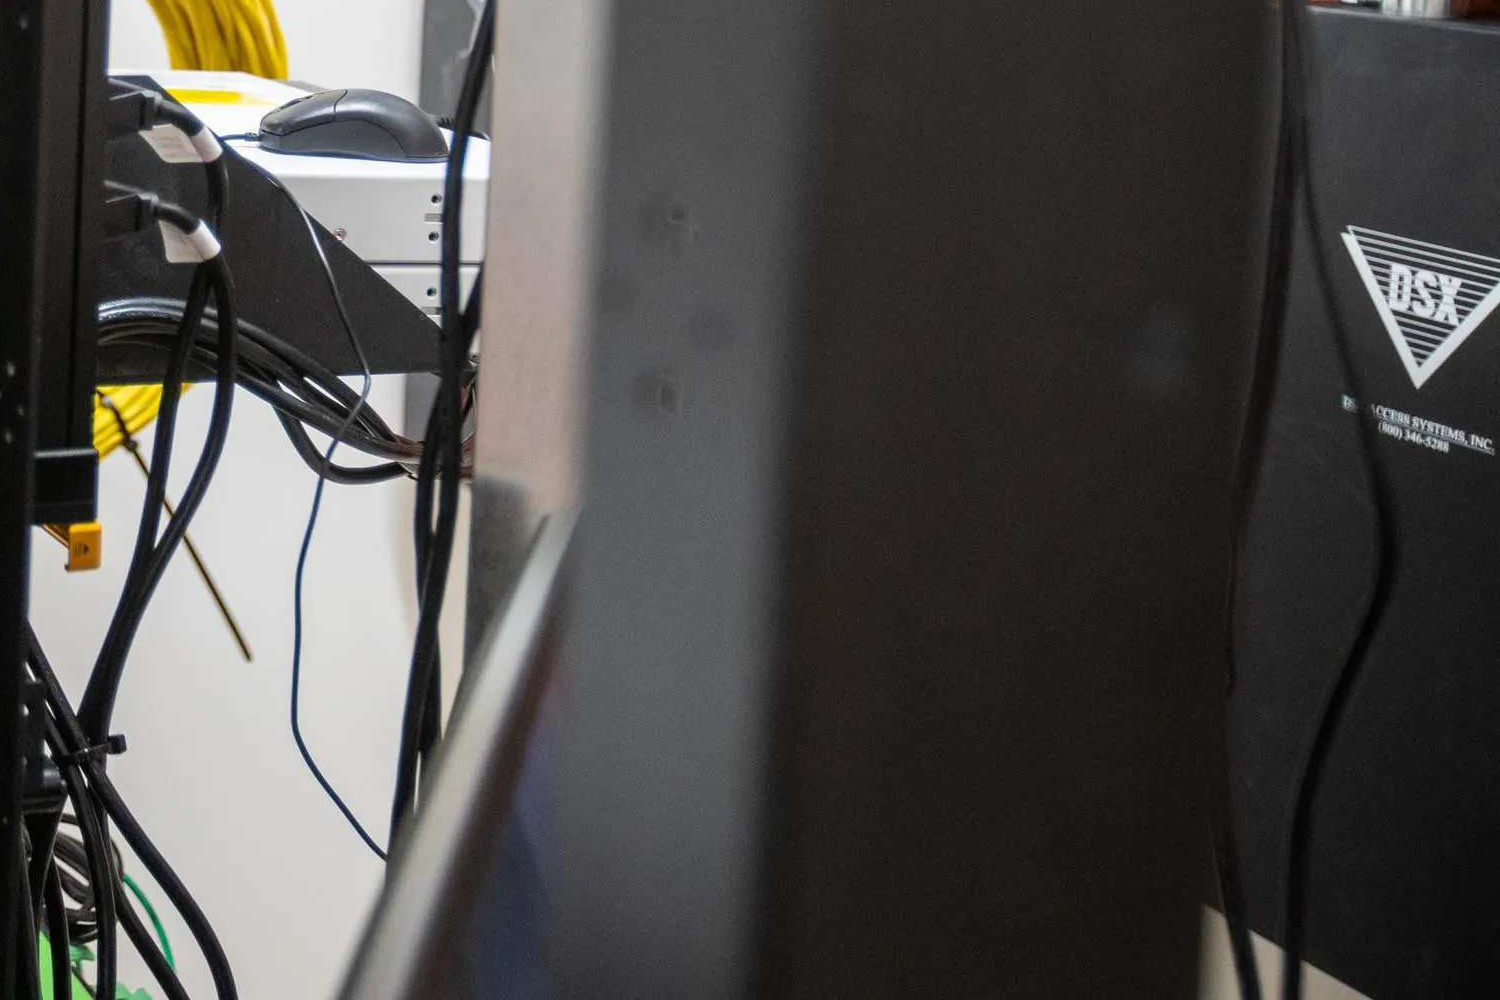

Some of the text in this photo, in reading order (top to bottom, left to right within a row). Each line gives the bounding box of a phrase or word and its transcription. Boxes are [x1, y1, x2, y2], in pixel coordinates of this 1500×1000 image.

[1389, 263, 1461, 327] DSX
[1378, 420, 1403, 441] (800)
[1469, 433, 1495, 453] INC.
